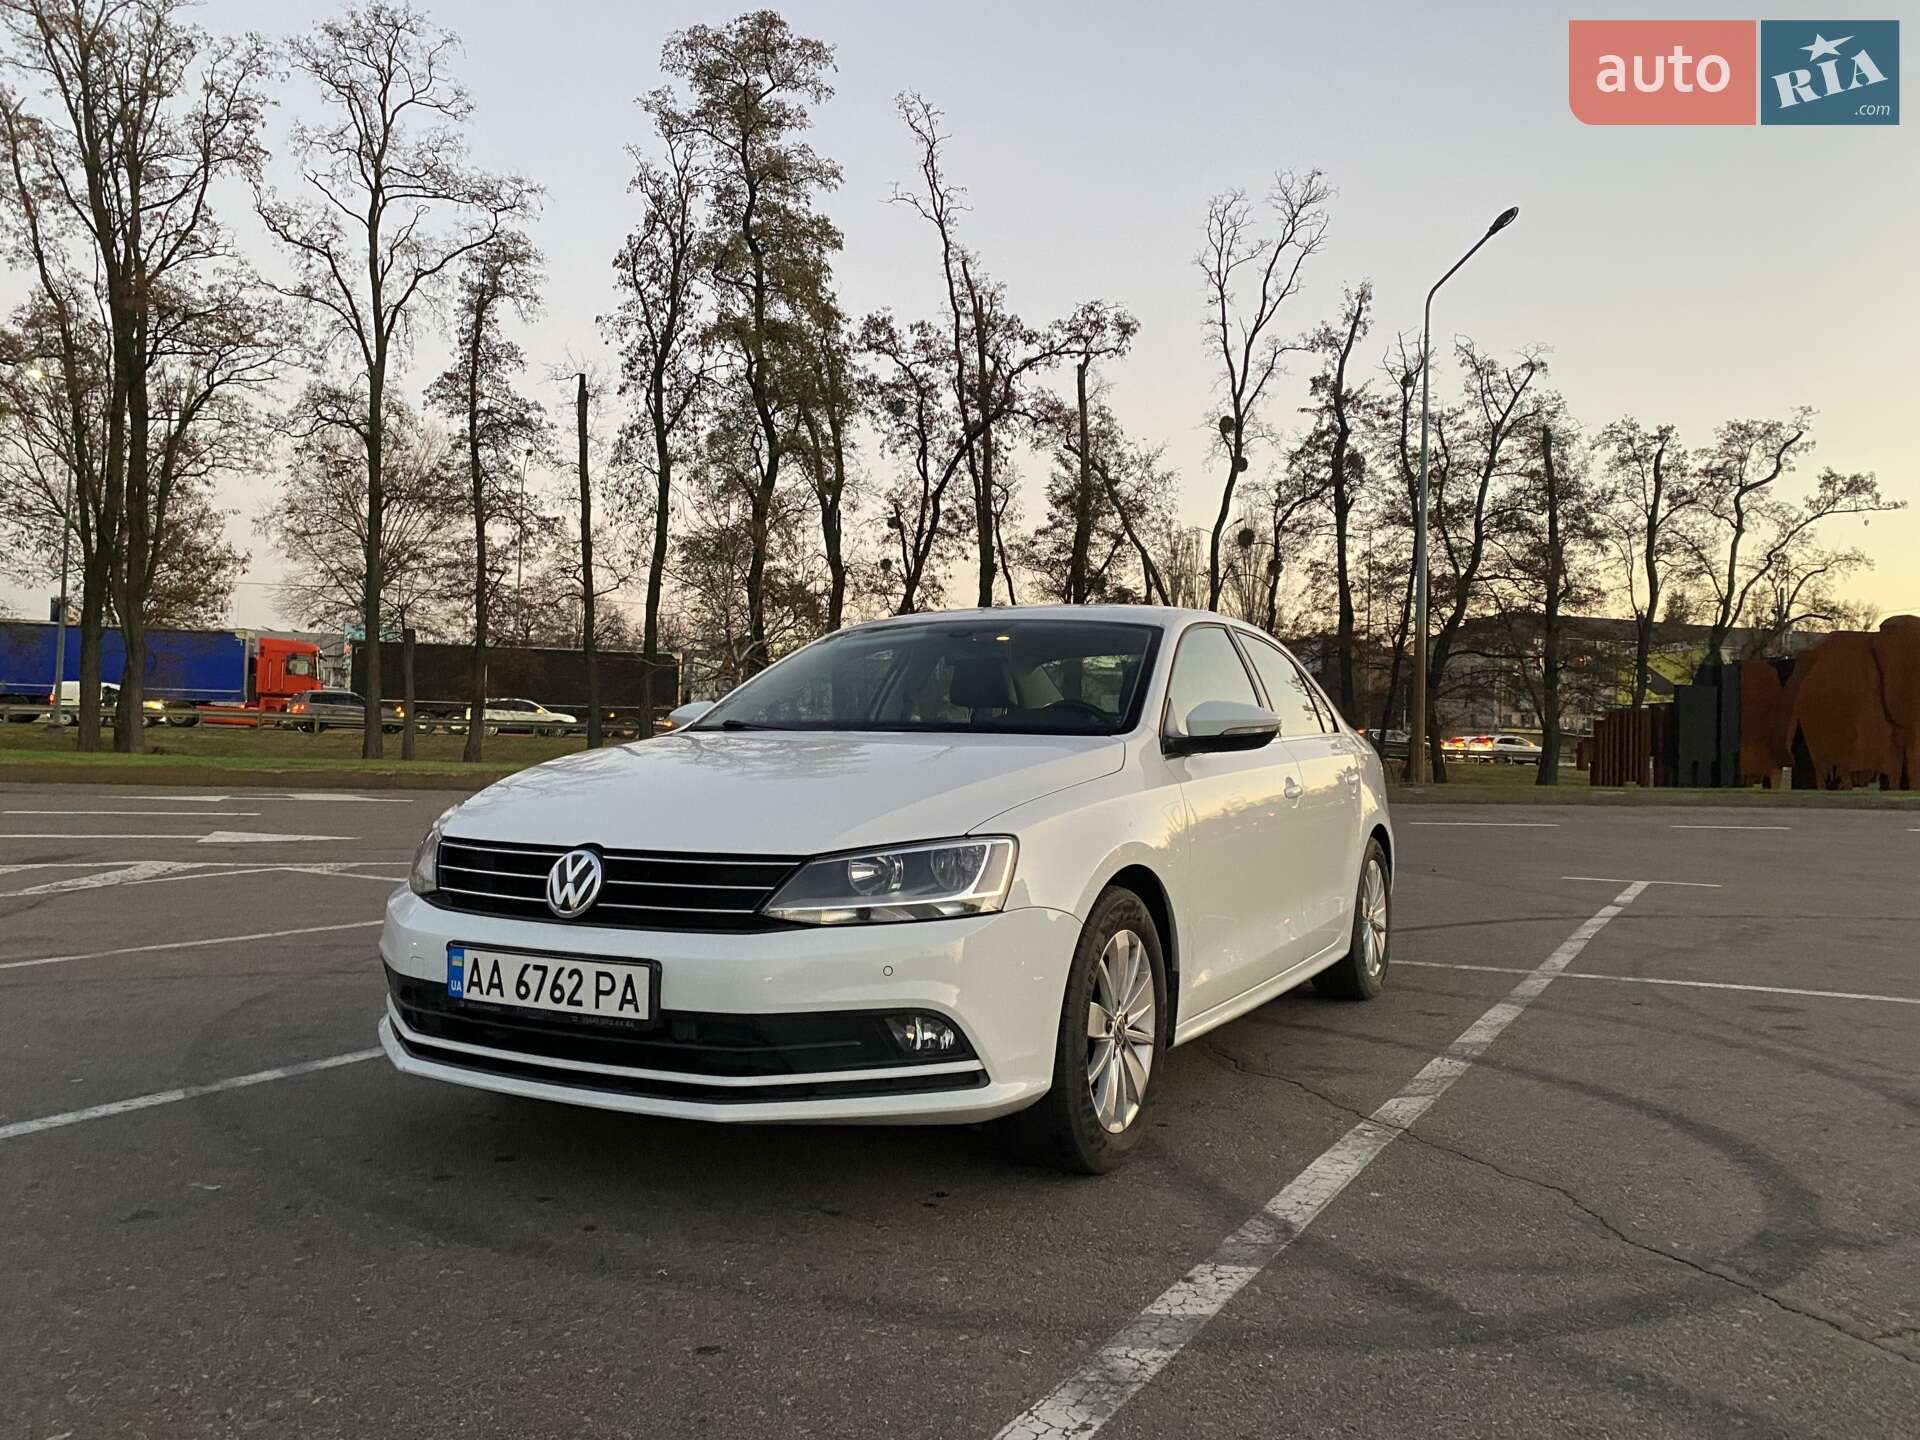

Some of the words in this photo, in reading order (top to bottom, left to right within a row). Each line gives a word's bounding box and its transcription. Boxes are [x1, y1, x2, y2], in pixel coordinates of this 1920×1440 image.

[450, 979, 463, 992] UA
[466, 957, 505, 998] AA
[515, 963, 584, 1007] 6762
[594, 970, 640, 1013] PA
